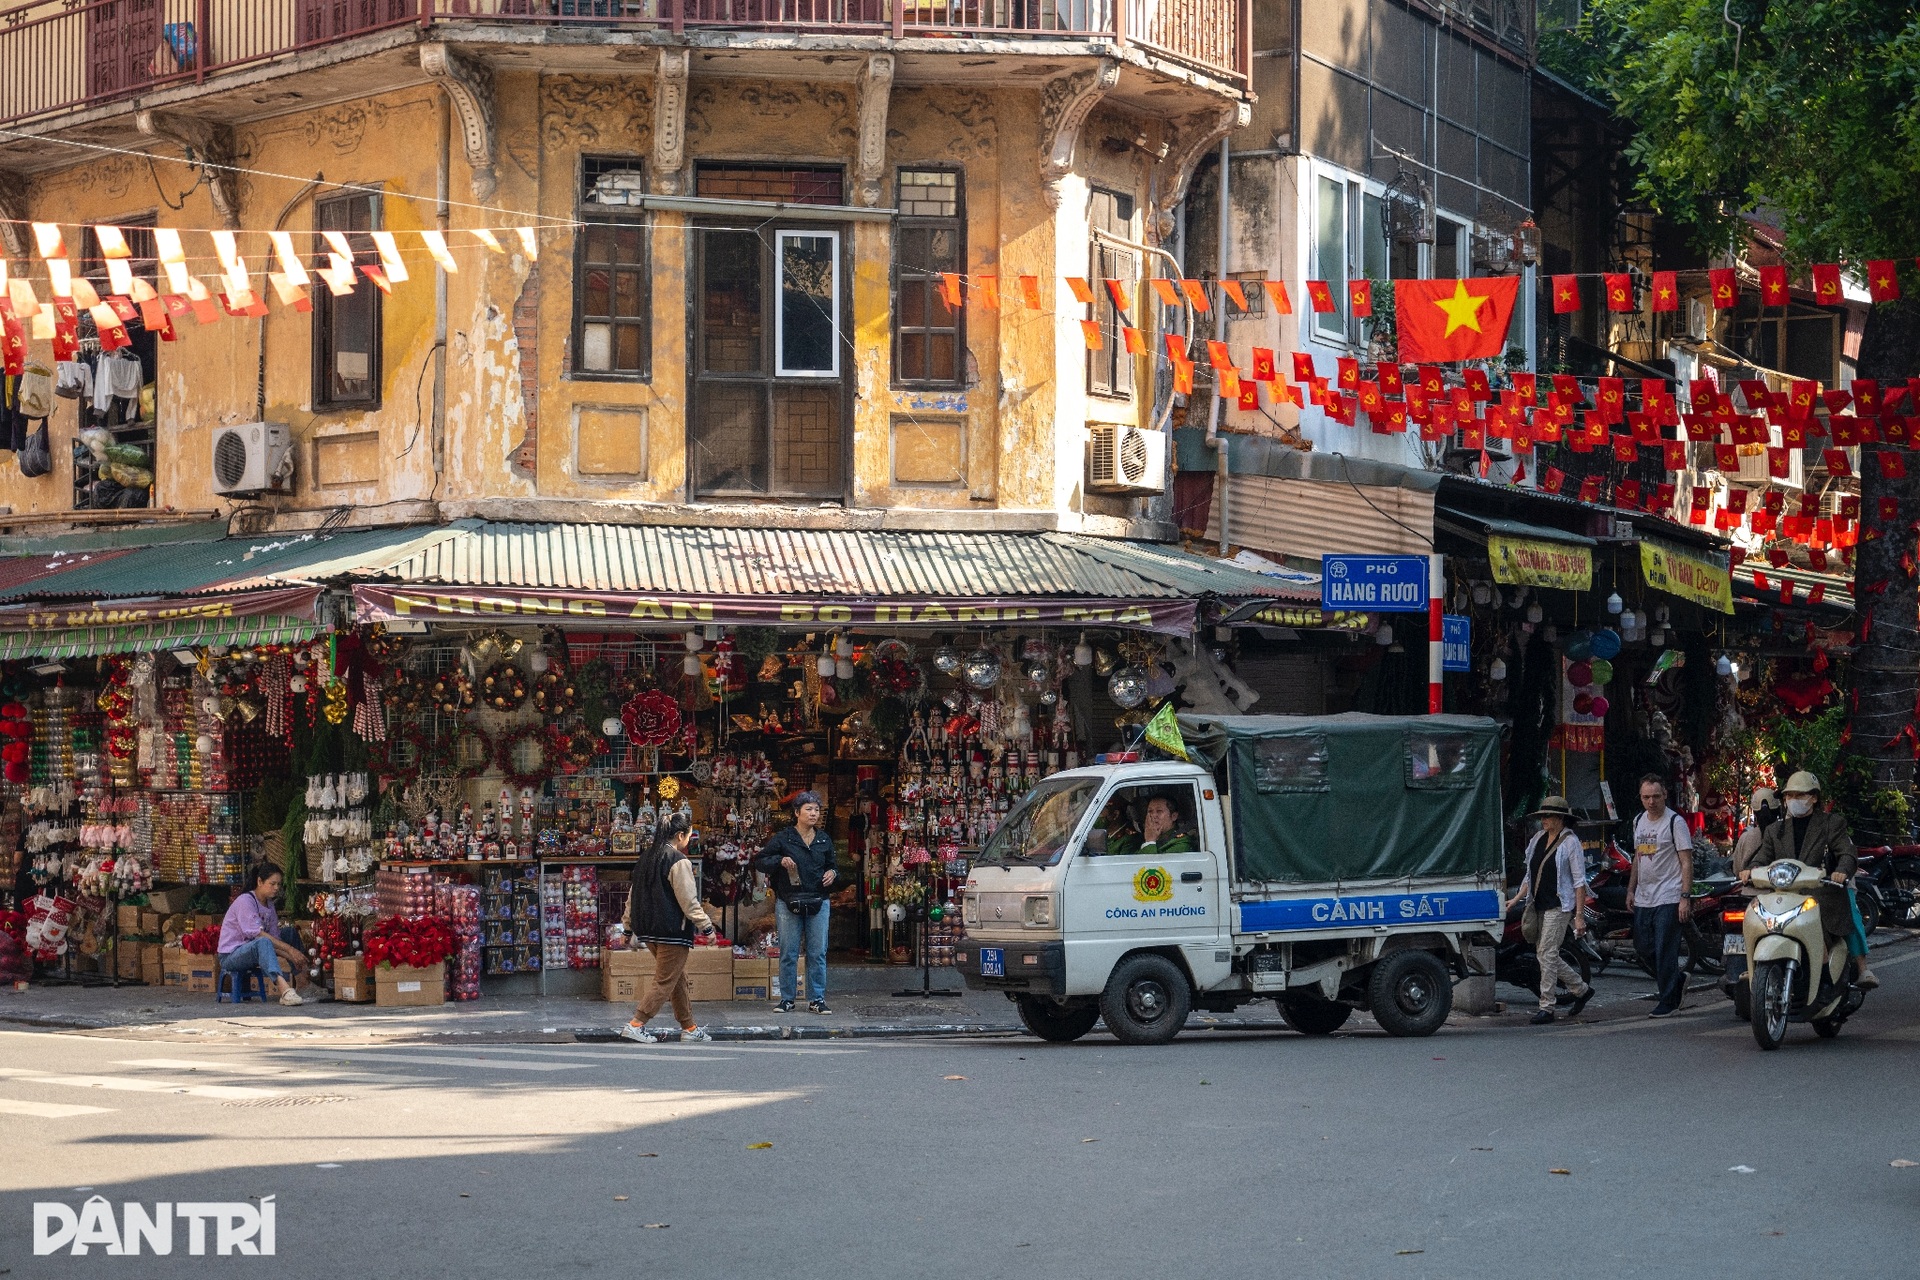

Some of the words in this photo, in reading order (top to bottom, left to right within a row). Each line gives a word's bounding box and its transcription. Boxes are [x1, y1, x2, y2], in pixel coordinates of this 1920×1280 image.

[1366, 561, 1399, 575] PHỐ
[1331, 579, 1376, 602] HÀNG
[1380, 581, 1419, 602] RƯƠI
[1696, 568, 1720, 595] Deor
[393, 596, 608, 616] PHONG
[779, 604, 852, 622] 56
[1450, 622, 1462, 635] PHỐ
[1105, 907, 1138, 919] CÔNG
[1141, 908, 1156, 918] AN
[1159, 904, 1206, 917] PHƯỜNG
[1311, 898, 1385, 922] CẢNH
[1399, 895, 1449, 918] SÁT
